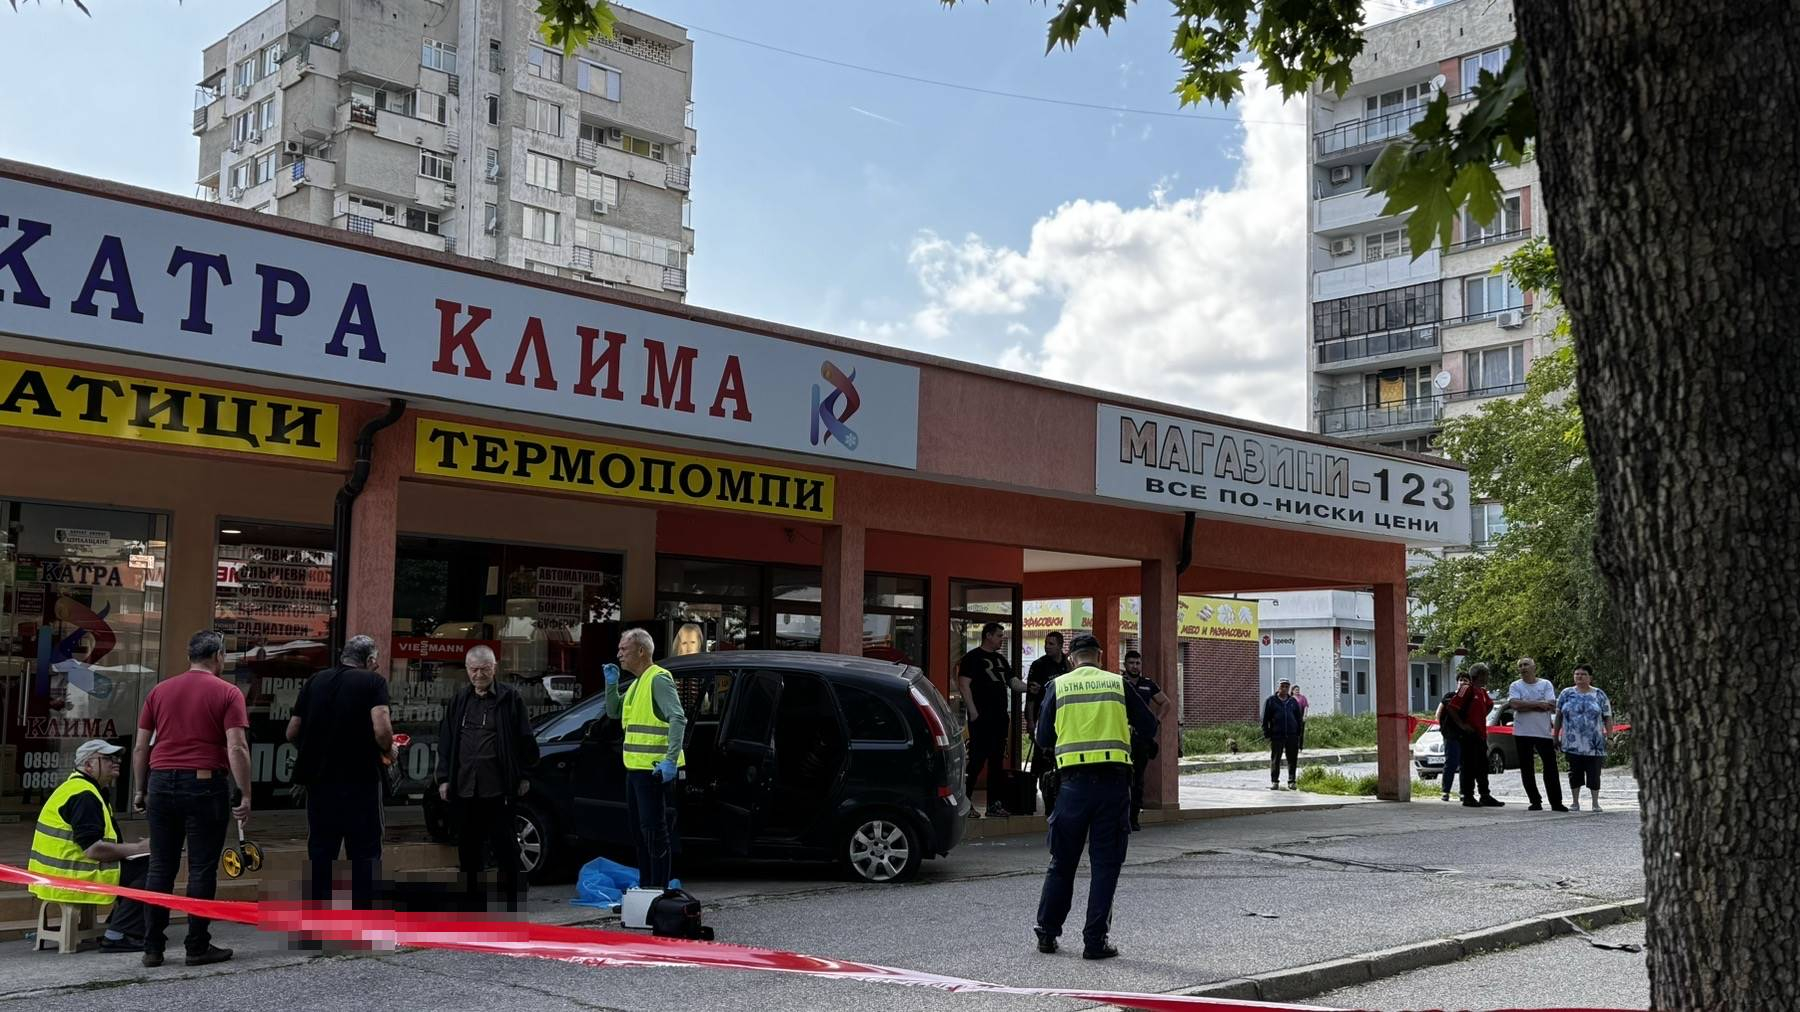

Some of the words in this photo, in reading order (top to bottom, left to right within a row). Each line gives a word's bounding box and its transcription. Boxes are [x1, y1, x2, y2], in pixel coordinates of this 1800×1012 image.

[0, 213, 387, 363] КАТРА
[431, 297, 753, 422] КЛИМА
[0, 370, 323, 448] АТИЦИ
[429, 427, 825, 513] ТЕРМОПОМПИ
[1119, 415, 1456, 512] МАГАЗИНИ-123
[1145, 477, 1208, 500] ВСЕ
[1219, 489, 1364, 524] ПО-НИСКИ
[1374, 513, 1440, 533] ЦЕНИ
[41, 560, 123, 587] КАТРА
[538, 568, 601, 584] АВТОМАТИКА
[538, 584, 573, 597] ПОМПИ
[1201, 626, 1208, 636] И
[398, 640, 464, 657] VIESSMANN
[1273, 636, 1296, 646] speedy
[1085, 680, 1121, 692] ПОЛИЦИЯ
[26, 717, 118, 738] КЛИМА
[24, 751, 60, 769] 0899
